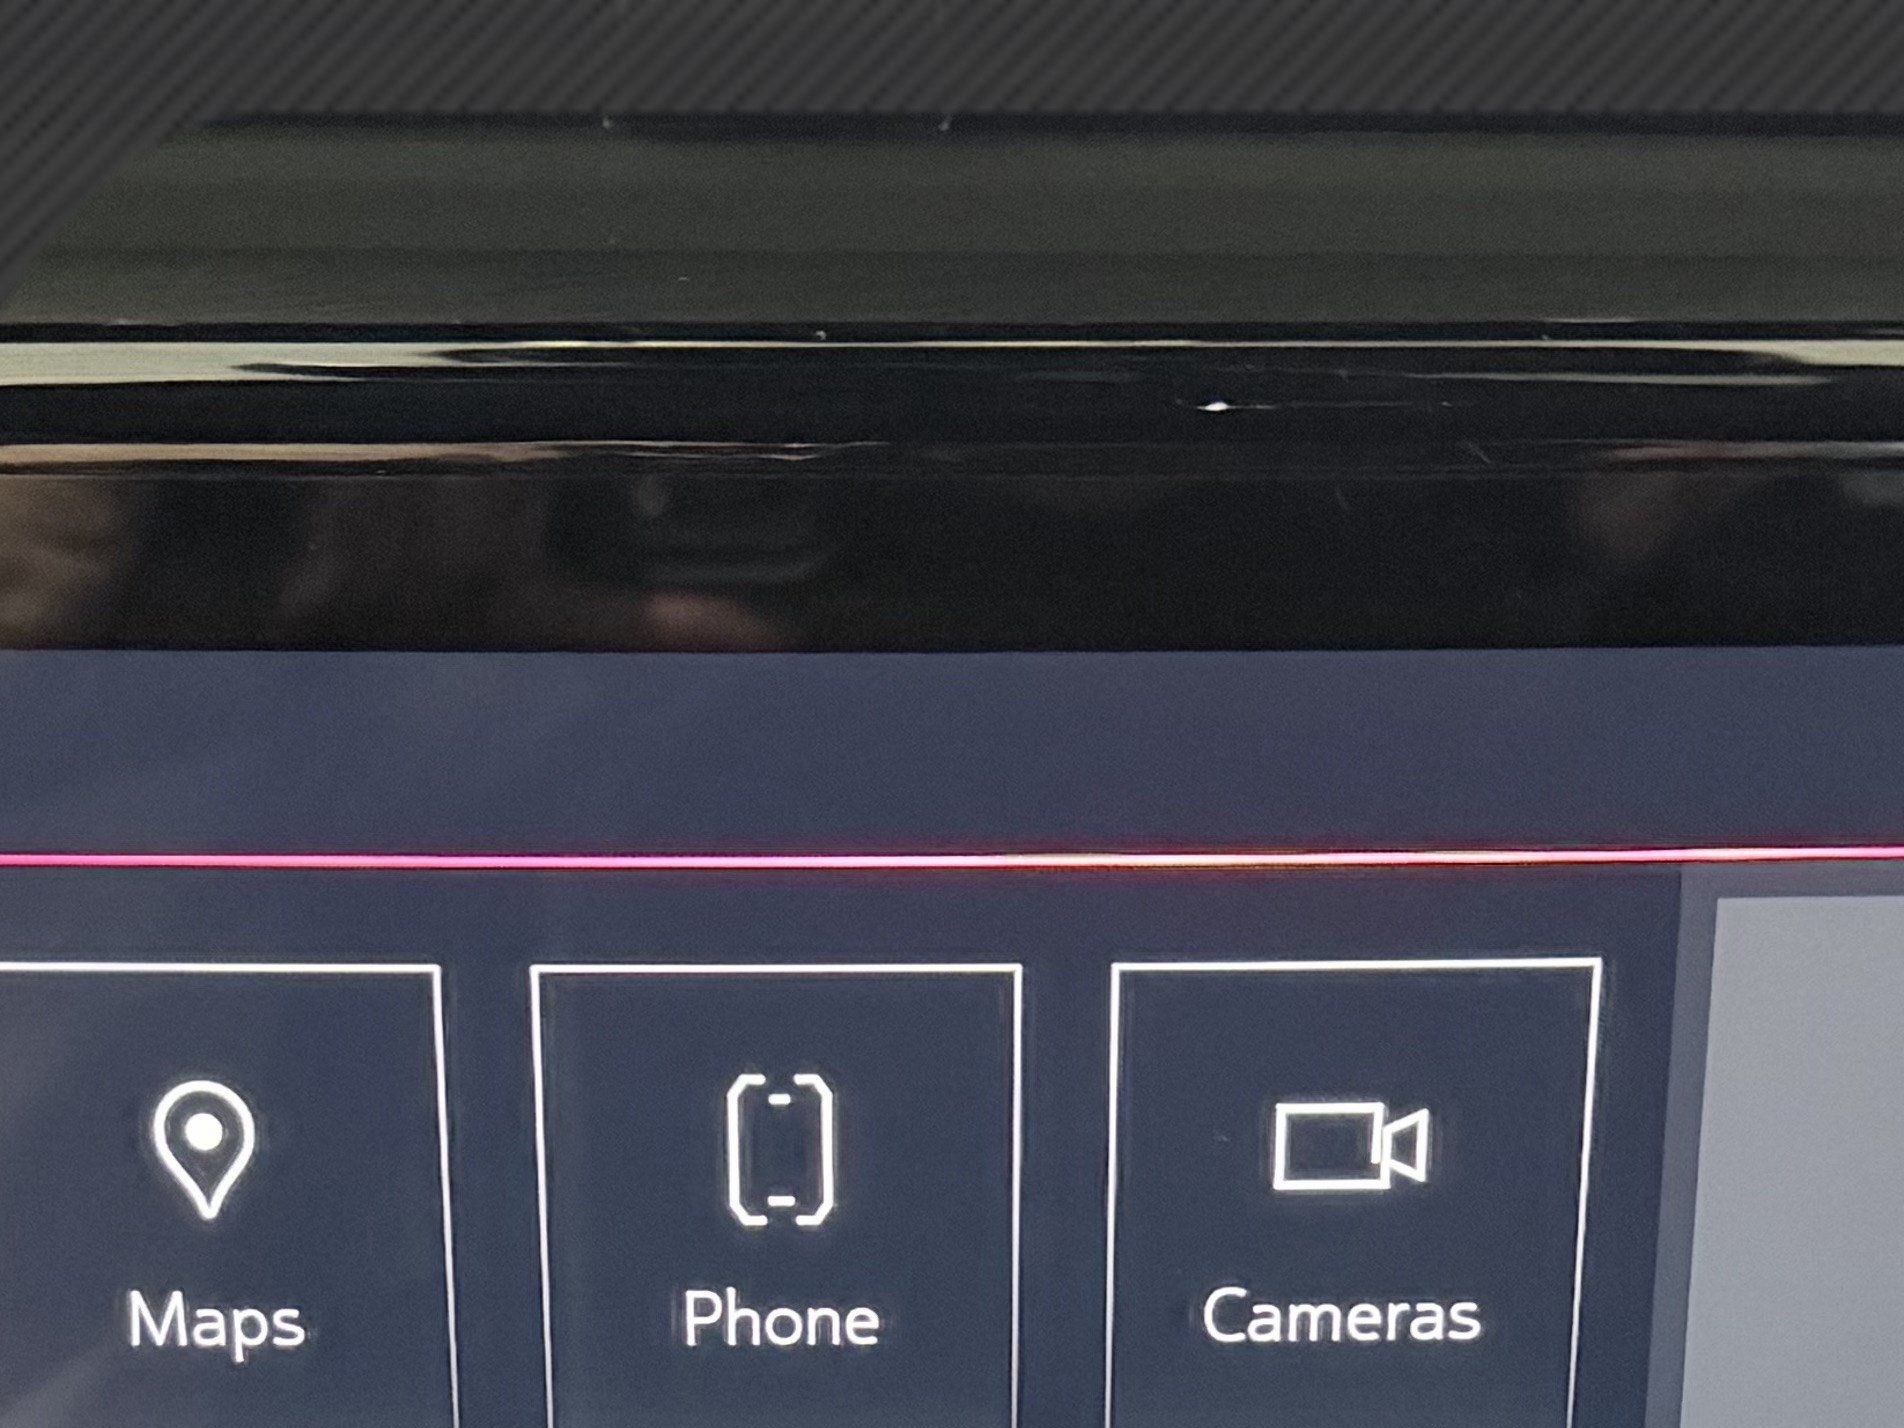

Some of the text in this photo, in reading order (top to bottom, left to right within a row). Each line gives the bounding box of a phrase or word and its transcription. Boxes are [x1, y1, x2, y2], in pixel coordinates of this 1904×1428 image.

[127, 1288, 308, 1364] Maps
[682, 1287, 882, 1346] Phone
[1202, 1285, 1483, 1343] Cameras
